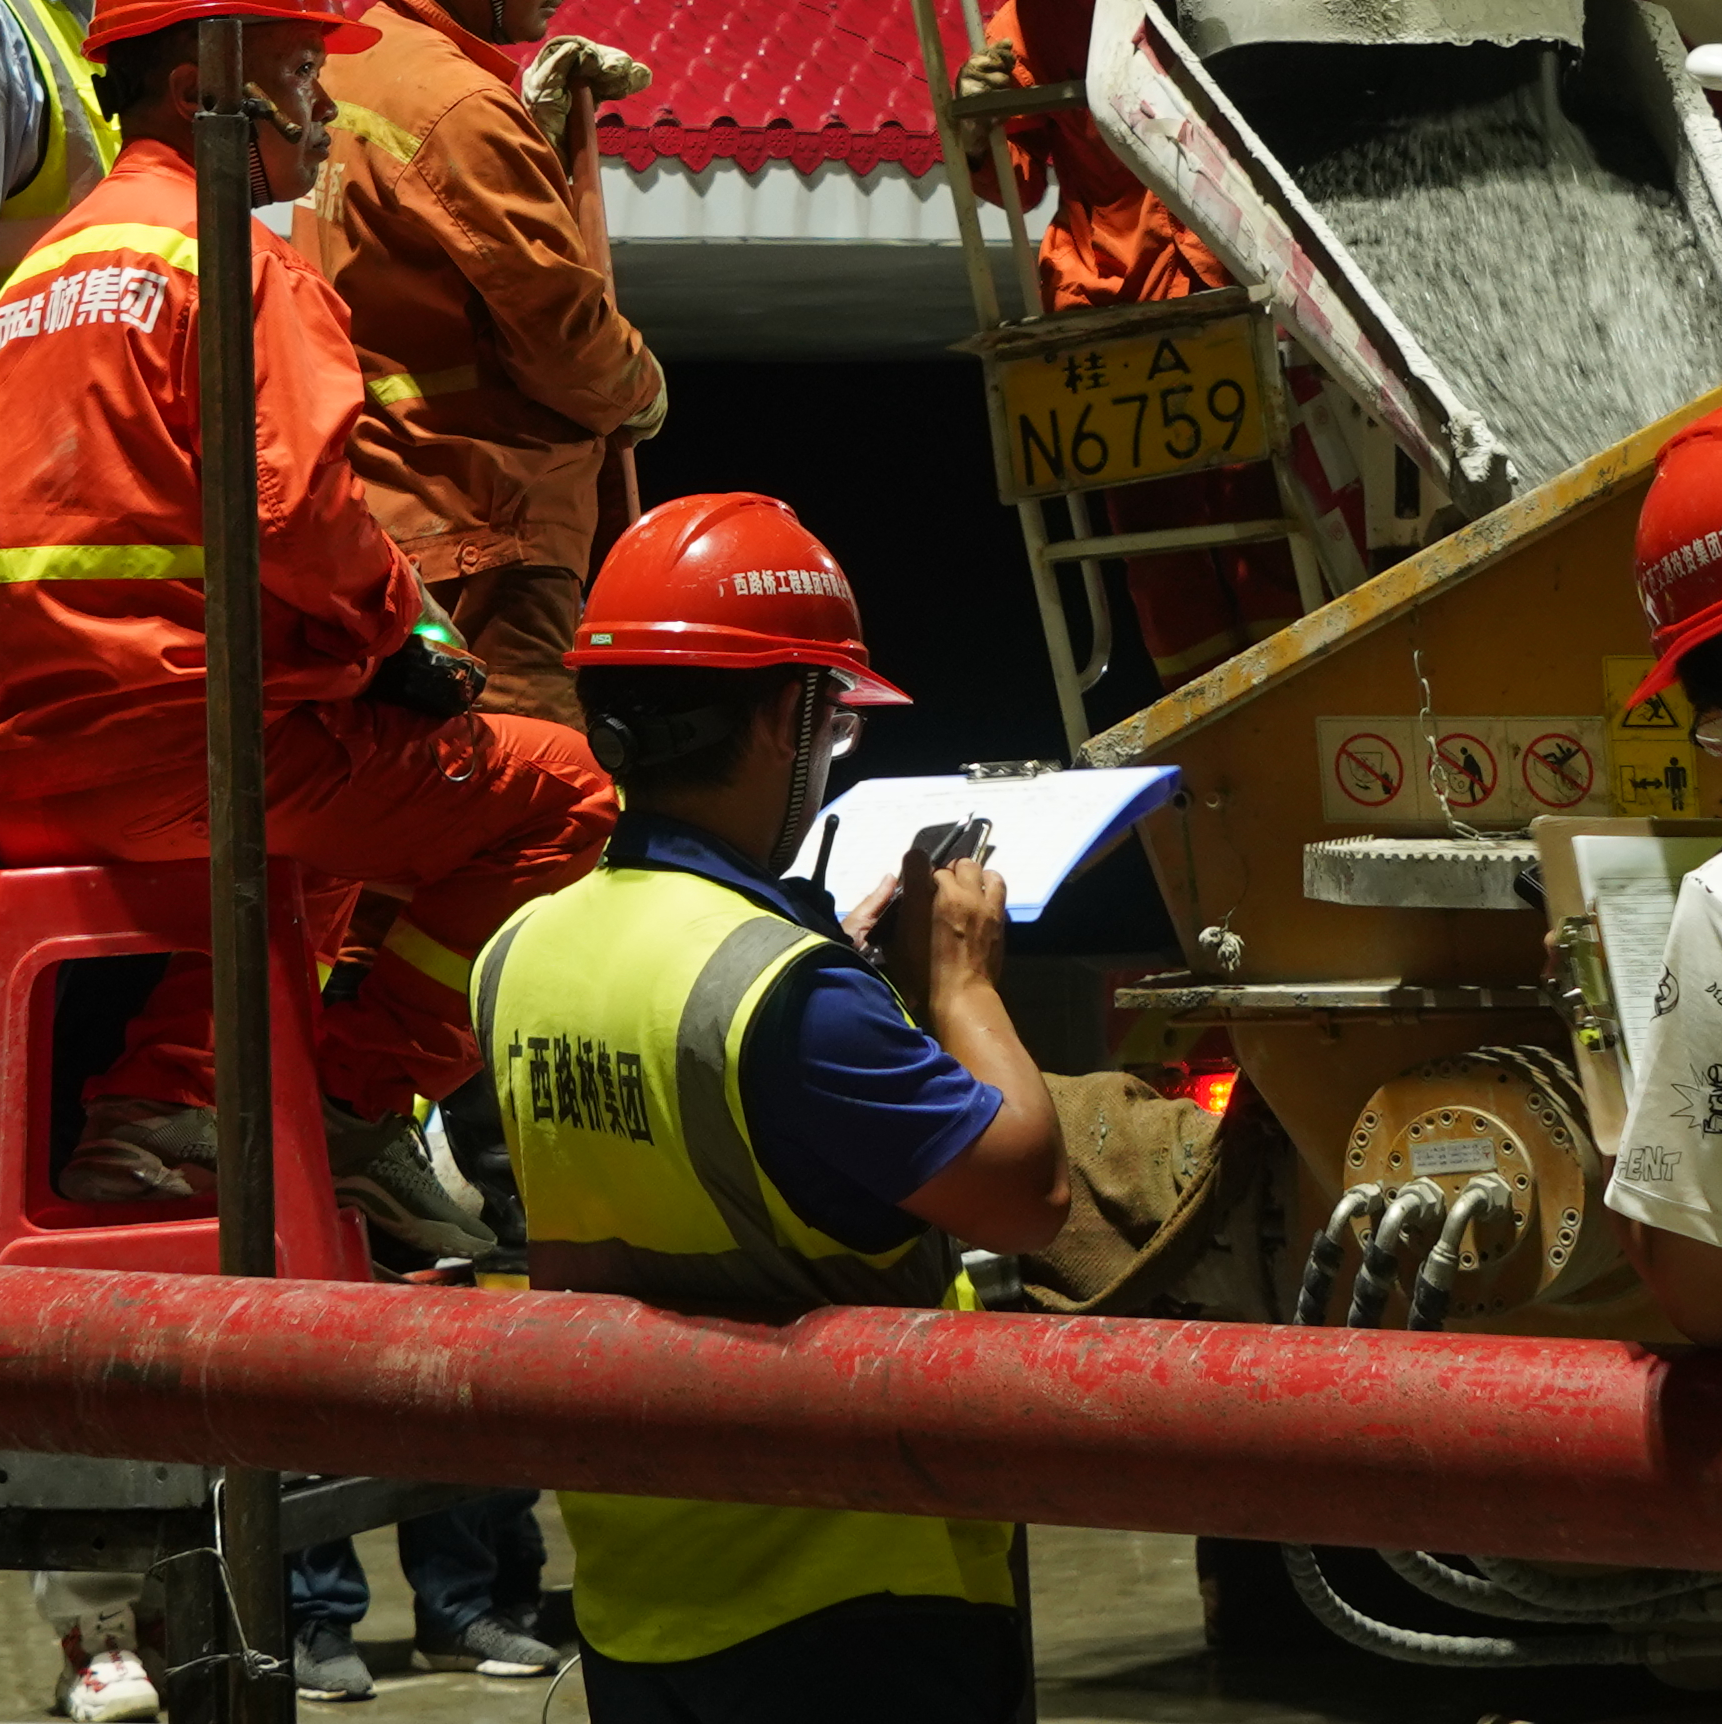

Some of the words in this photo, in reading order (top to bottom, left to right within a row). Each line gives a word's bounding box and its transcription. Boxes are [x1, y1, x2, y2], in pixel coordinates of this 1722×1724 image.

[1018, 378, 1246, 487] N6759
[507, 1028, 656, 1147] 广西路桥集团
